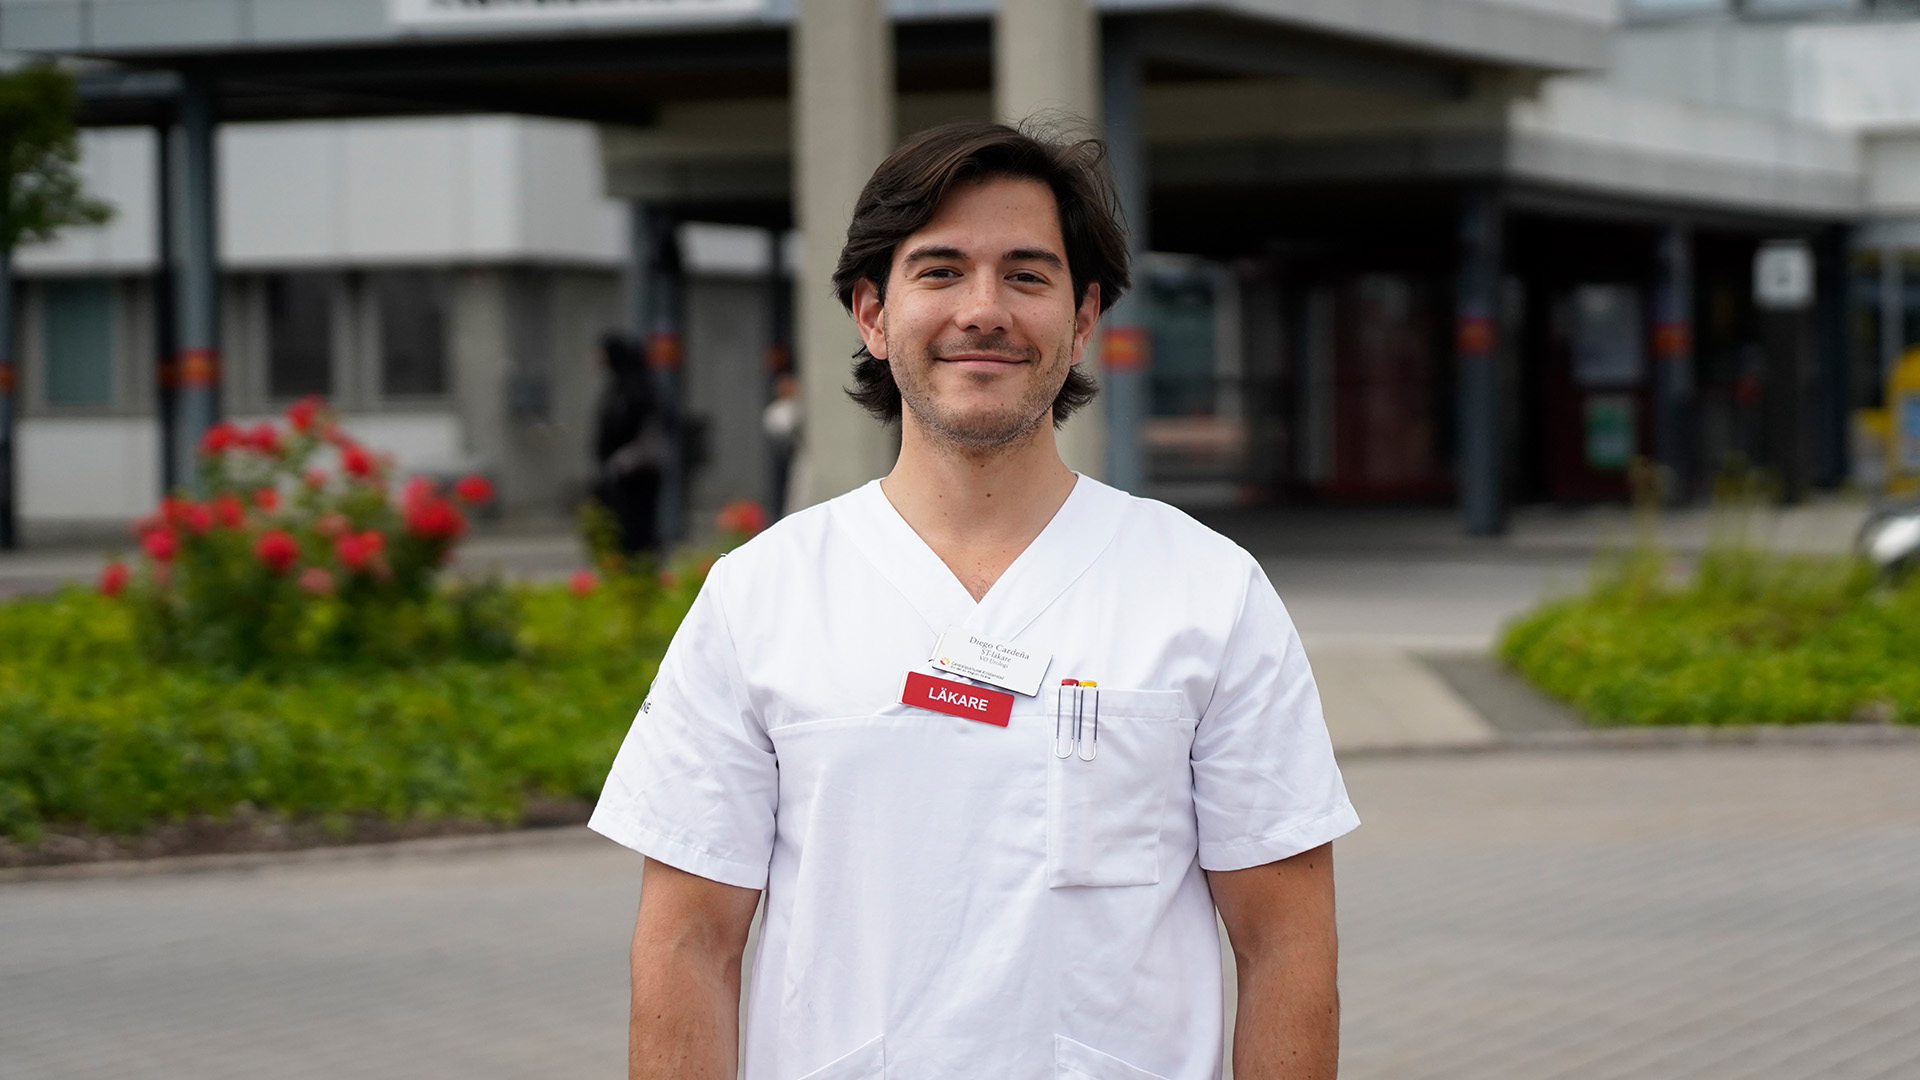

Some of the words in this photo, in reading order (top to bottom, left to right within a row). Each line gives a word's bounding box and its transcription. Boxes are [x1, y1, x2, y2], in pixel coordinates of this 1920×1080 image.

[969, 636, 993, 649] Diego
[995, 643, 1030, 660] Cardeña
[928, 687, 989, 711] LÄKARE
